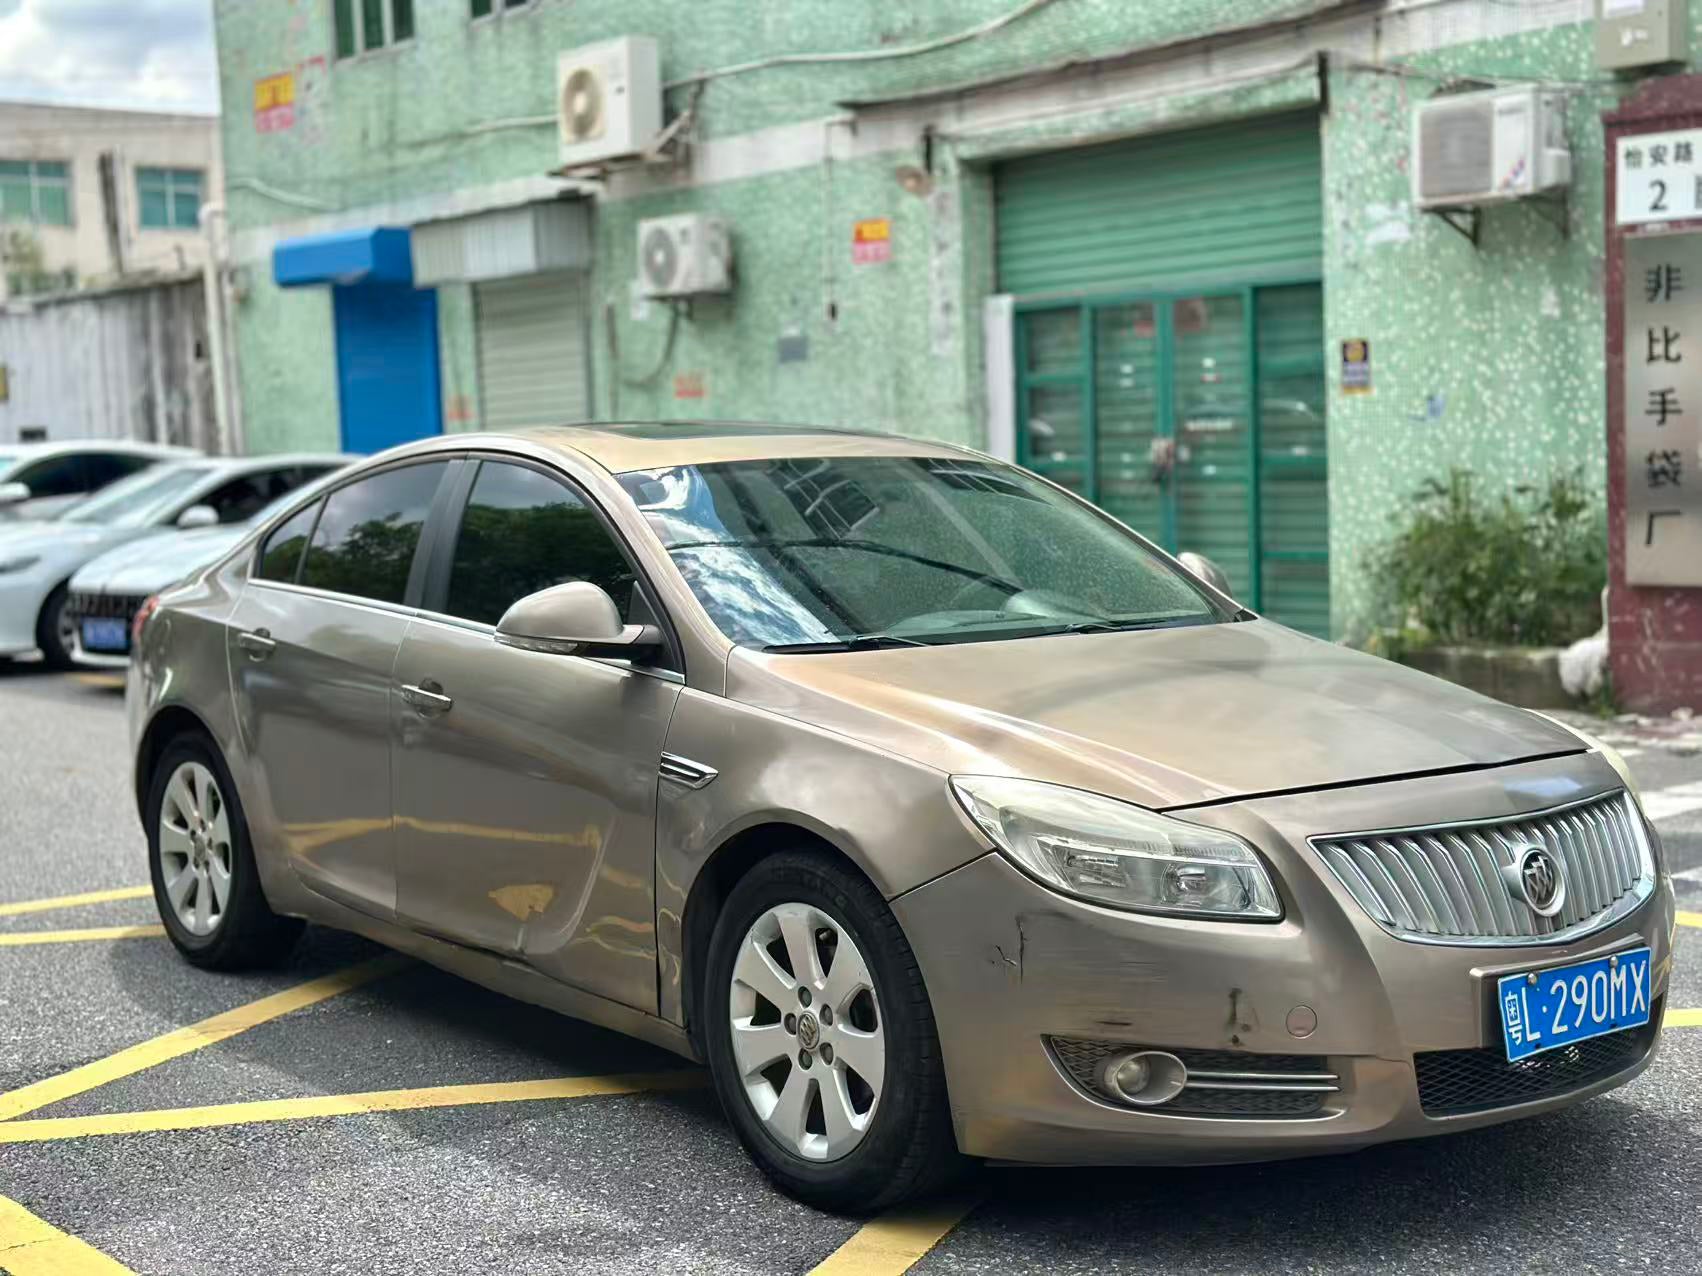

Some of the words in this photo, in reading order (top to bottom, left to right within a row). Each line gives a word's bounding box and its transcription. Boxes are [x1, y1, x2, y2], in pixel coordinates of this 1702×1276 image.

[1649, 179, 1668, 212] 2
[1645, 263, 1684, 547] 非比手袋厂
